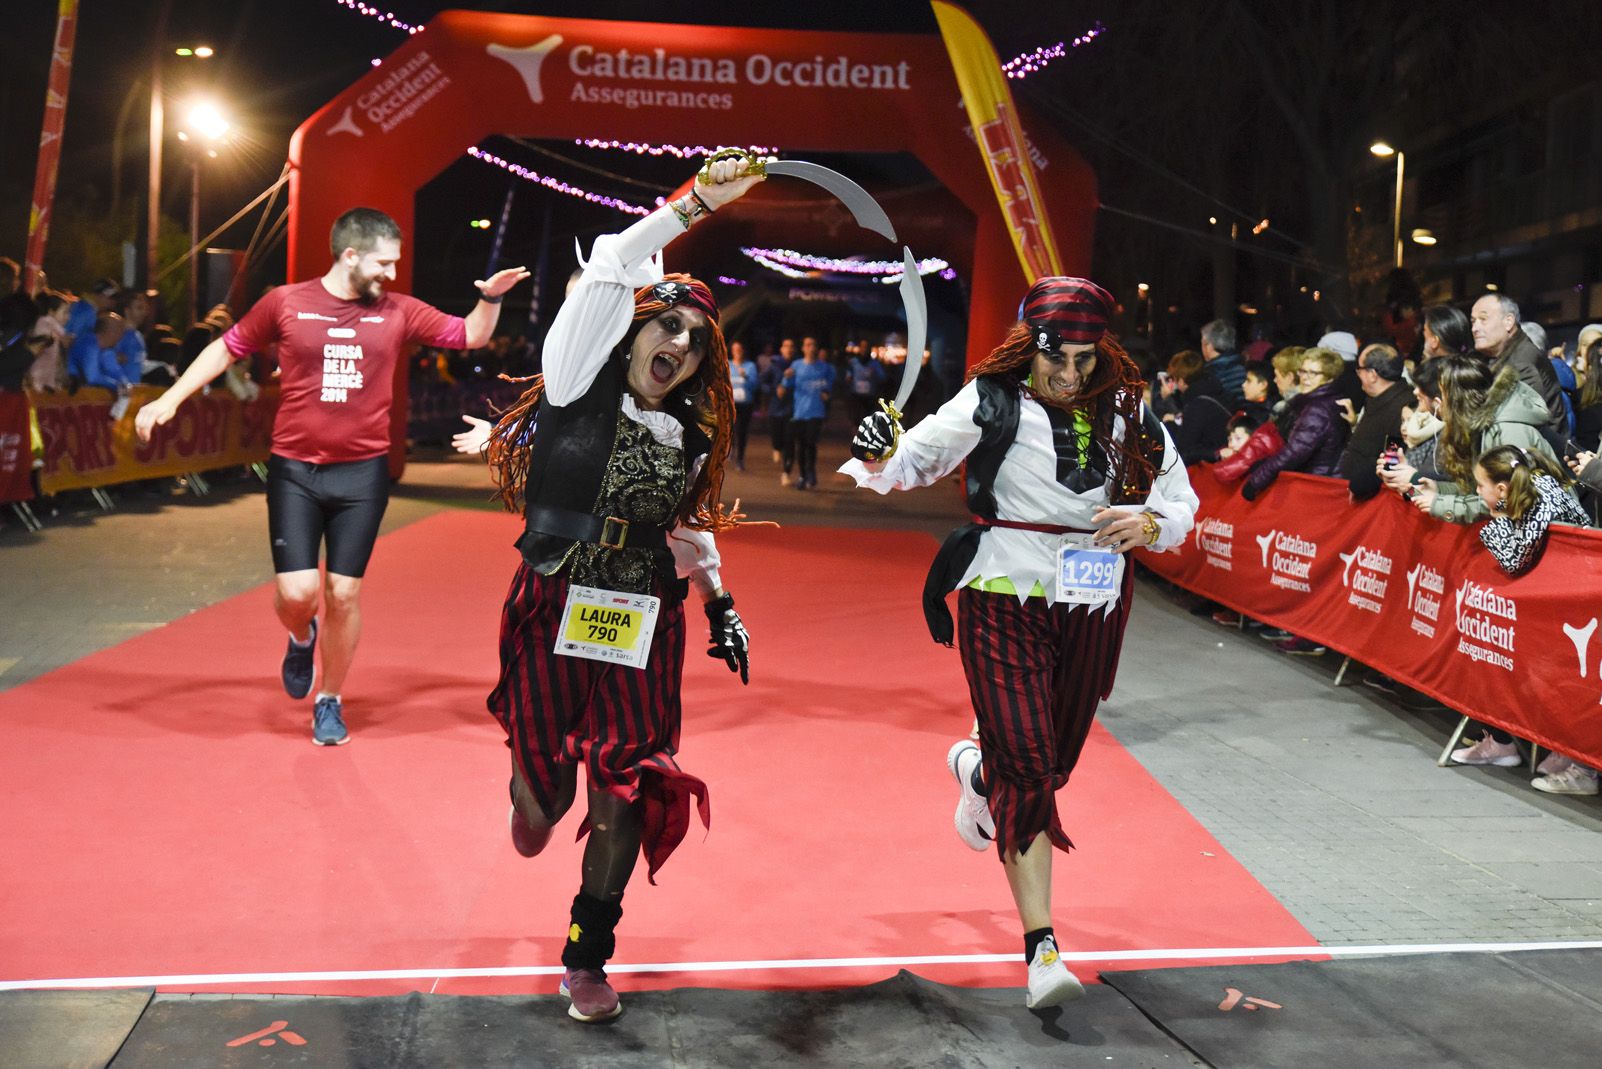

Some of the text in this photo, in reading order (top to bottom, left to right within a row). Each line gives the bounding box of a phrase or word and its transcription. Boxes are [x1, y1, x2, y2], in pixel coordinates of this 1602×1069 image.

[356, 51, 430, 110] Catalana
[568, 45, 911, 89] Catalana Occident
[367, 62, 441, 122] Occident
[570, 82, 733, 109] Assegurances
[323, 344, 363, 359] CURSA
[340, 359, 356, 374] LA
[1275, 531, 1317, 558] Catalana
[1064, 560, 1114, 586] 1299
[1272, 552, 1312, 579] Occident
[1357, 546, 1392, 575] Catalana
[1353, 569, 1388, 599] Occident
[1419, 564, 1445, 595] Catalana
[580, 607, 631, 628] LAURA
[647, 600, 657, 614] 790
[1414, 590, 1440, 622] Occident
[588, 625, 618, 643] 790
